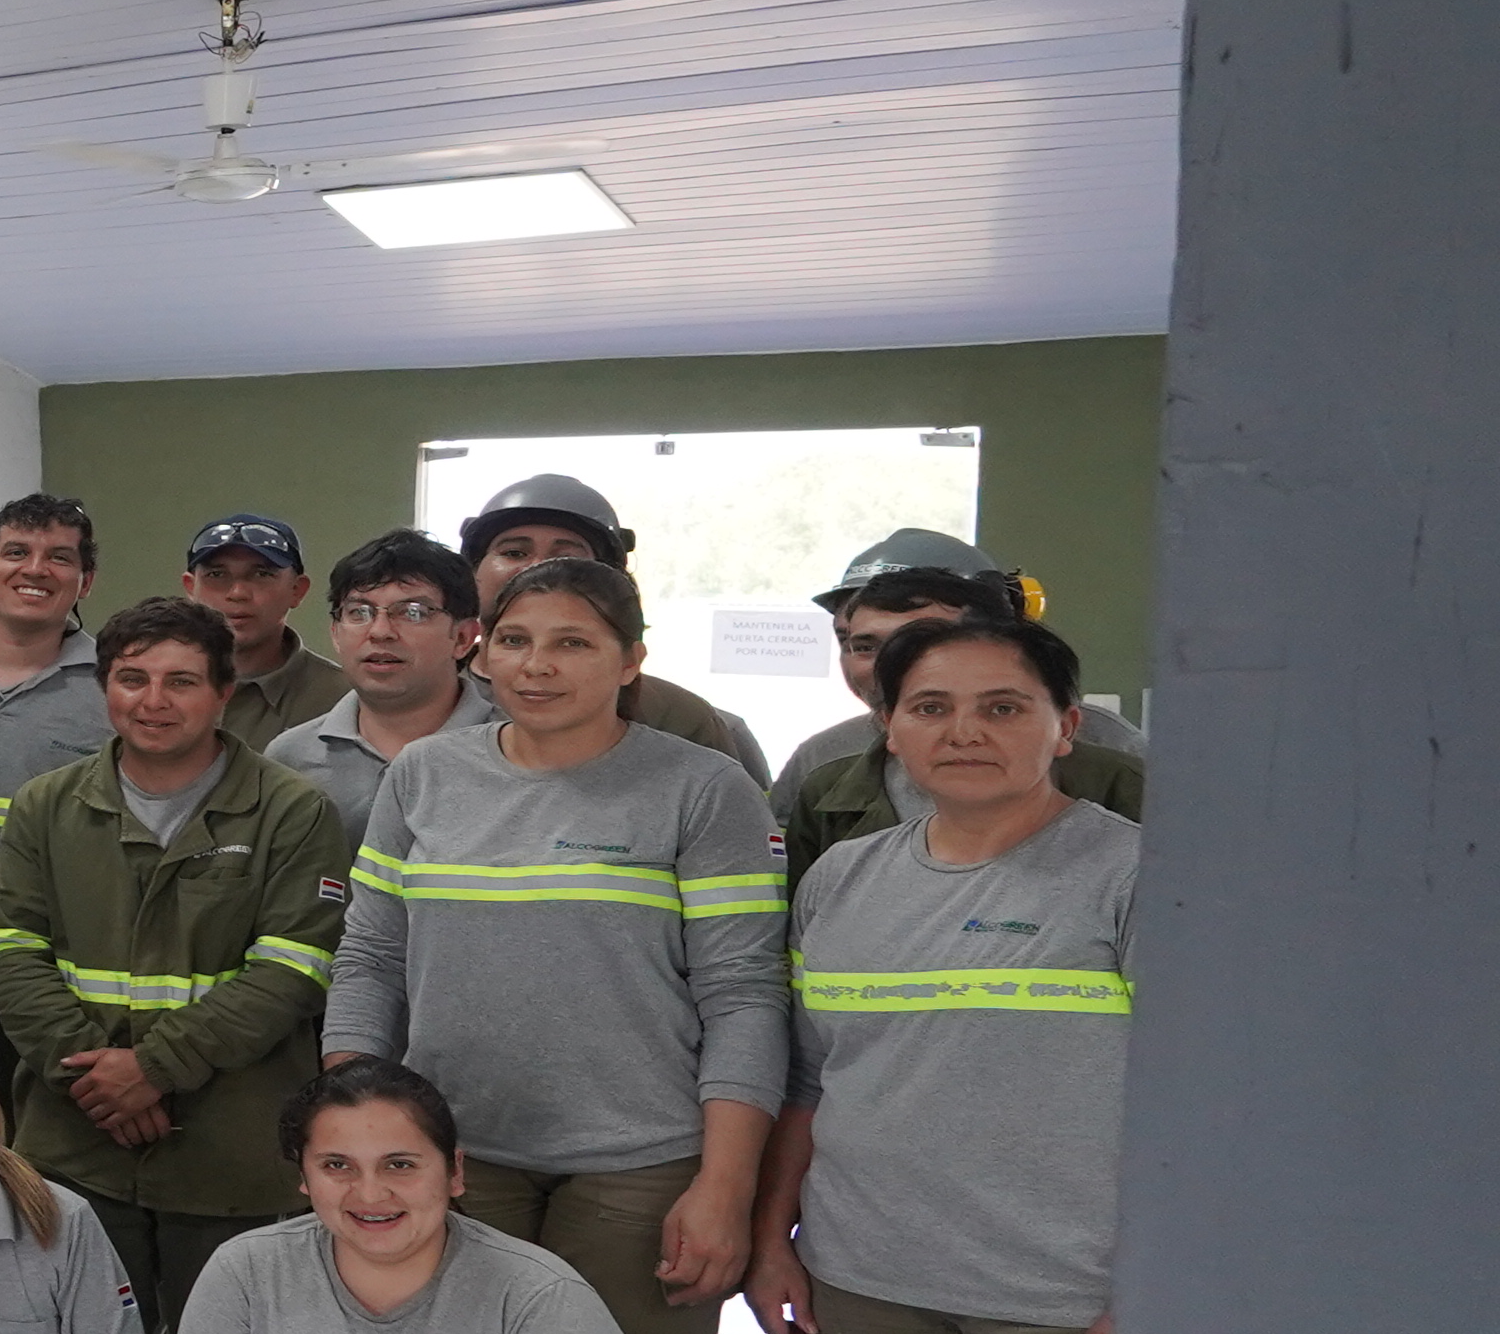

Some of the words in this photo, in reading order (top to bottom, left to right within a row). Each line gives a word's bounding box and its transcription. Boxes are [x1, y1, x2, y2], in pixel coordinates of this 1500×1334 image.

[732, 621, 794, 631] MANTENER
[797, 623, 811, 631] LA
[723, 633, 764, 643] PUERTA
[767, 635, 819, 645] CERRADA
[735, 647, 757, 656] POR
[563, 843, 632, 854] ALCOGREEN
